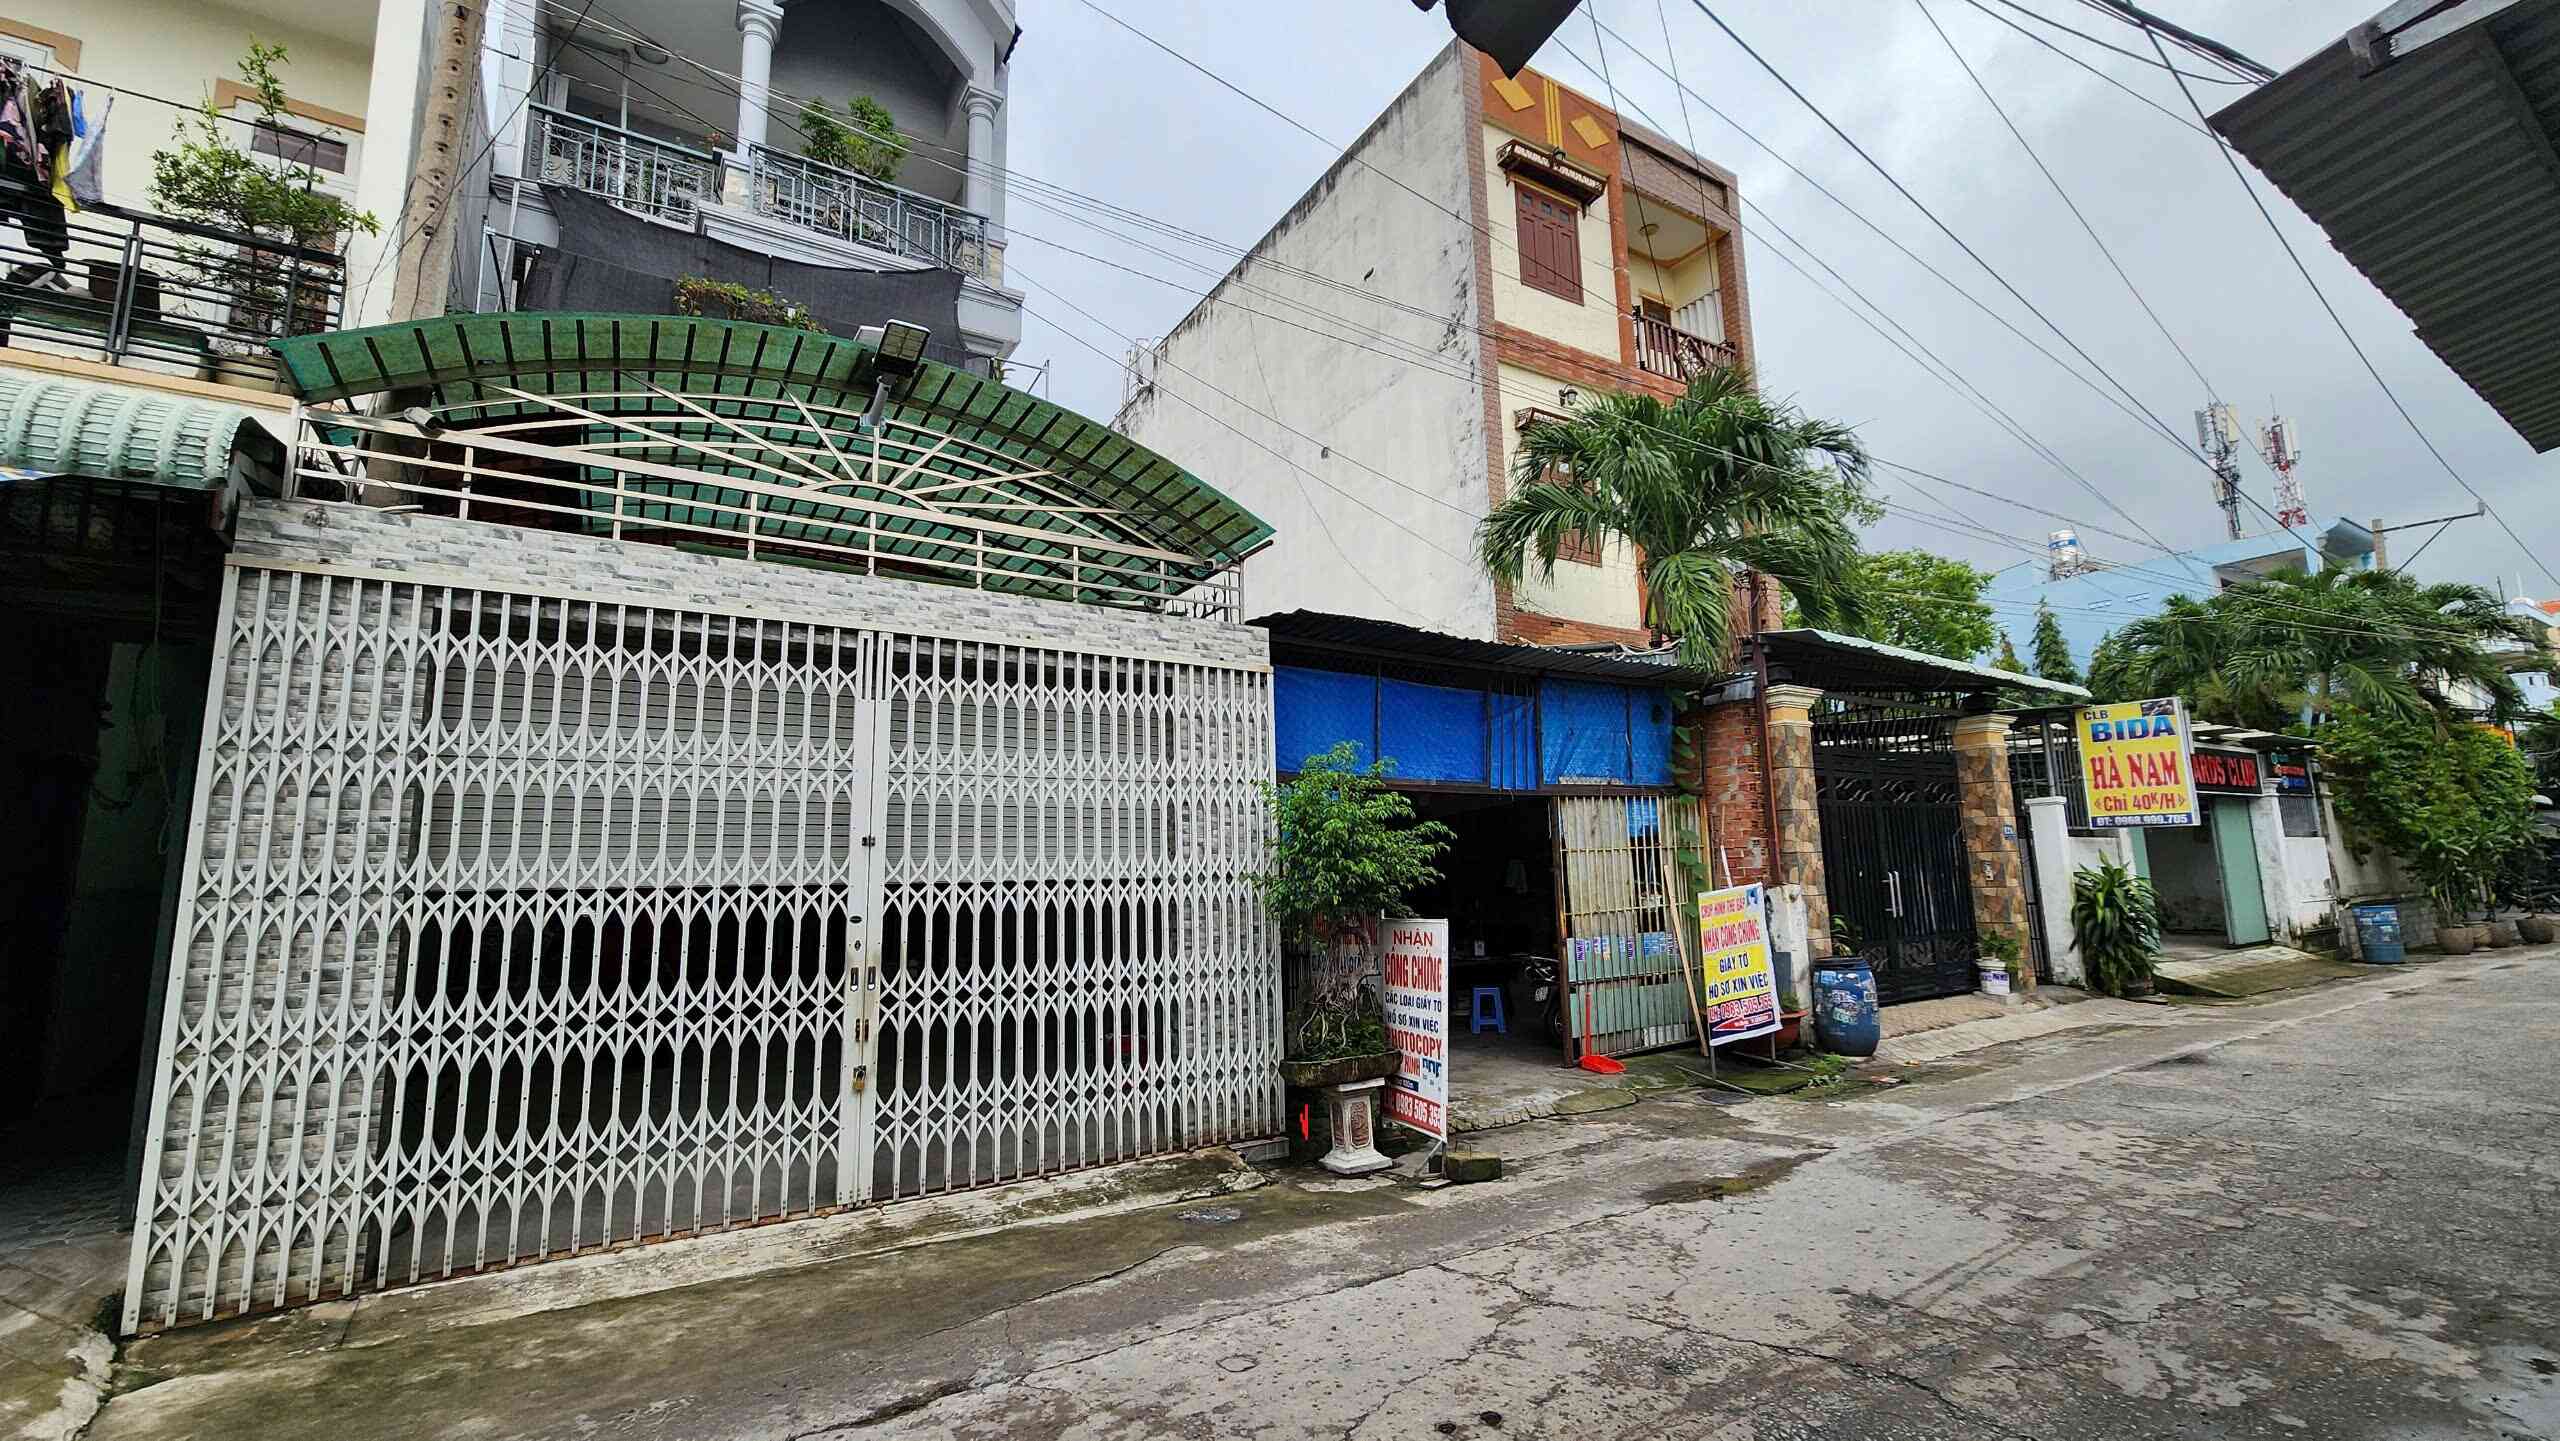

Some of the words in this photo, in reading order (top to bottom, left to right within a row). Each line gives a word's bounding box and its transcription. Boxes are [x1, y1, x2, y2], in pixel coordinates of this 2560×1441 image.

[2083, 710, 2109, 721] CLB
[2091, 715, 2177, 743] BIDA
[2090, 746, 2124, 790] HÀ
[2127, 750, 2181, 788] NAM
[2191, 753, 2226, 785] ARDS
[1393, 928, 1433, 950] NHẬN
[1384, 946, 1409, 988] CÔNG
[1732, 976, 1748, 993] XIN
[1408, 1015, 1420, 1029] XIN
[1395, 1092, 1413, 1118] 0983
[1413, 1098, 1428, 1123] 505
